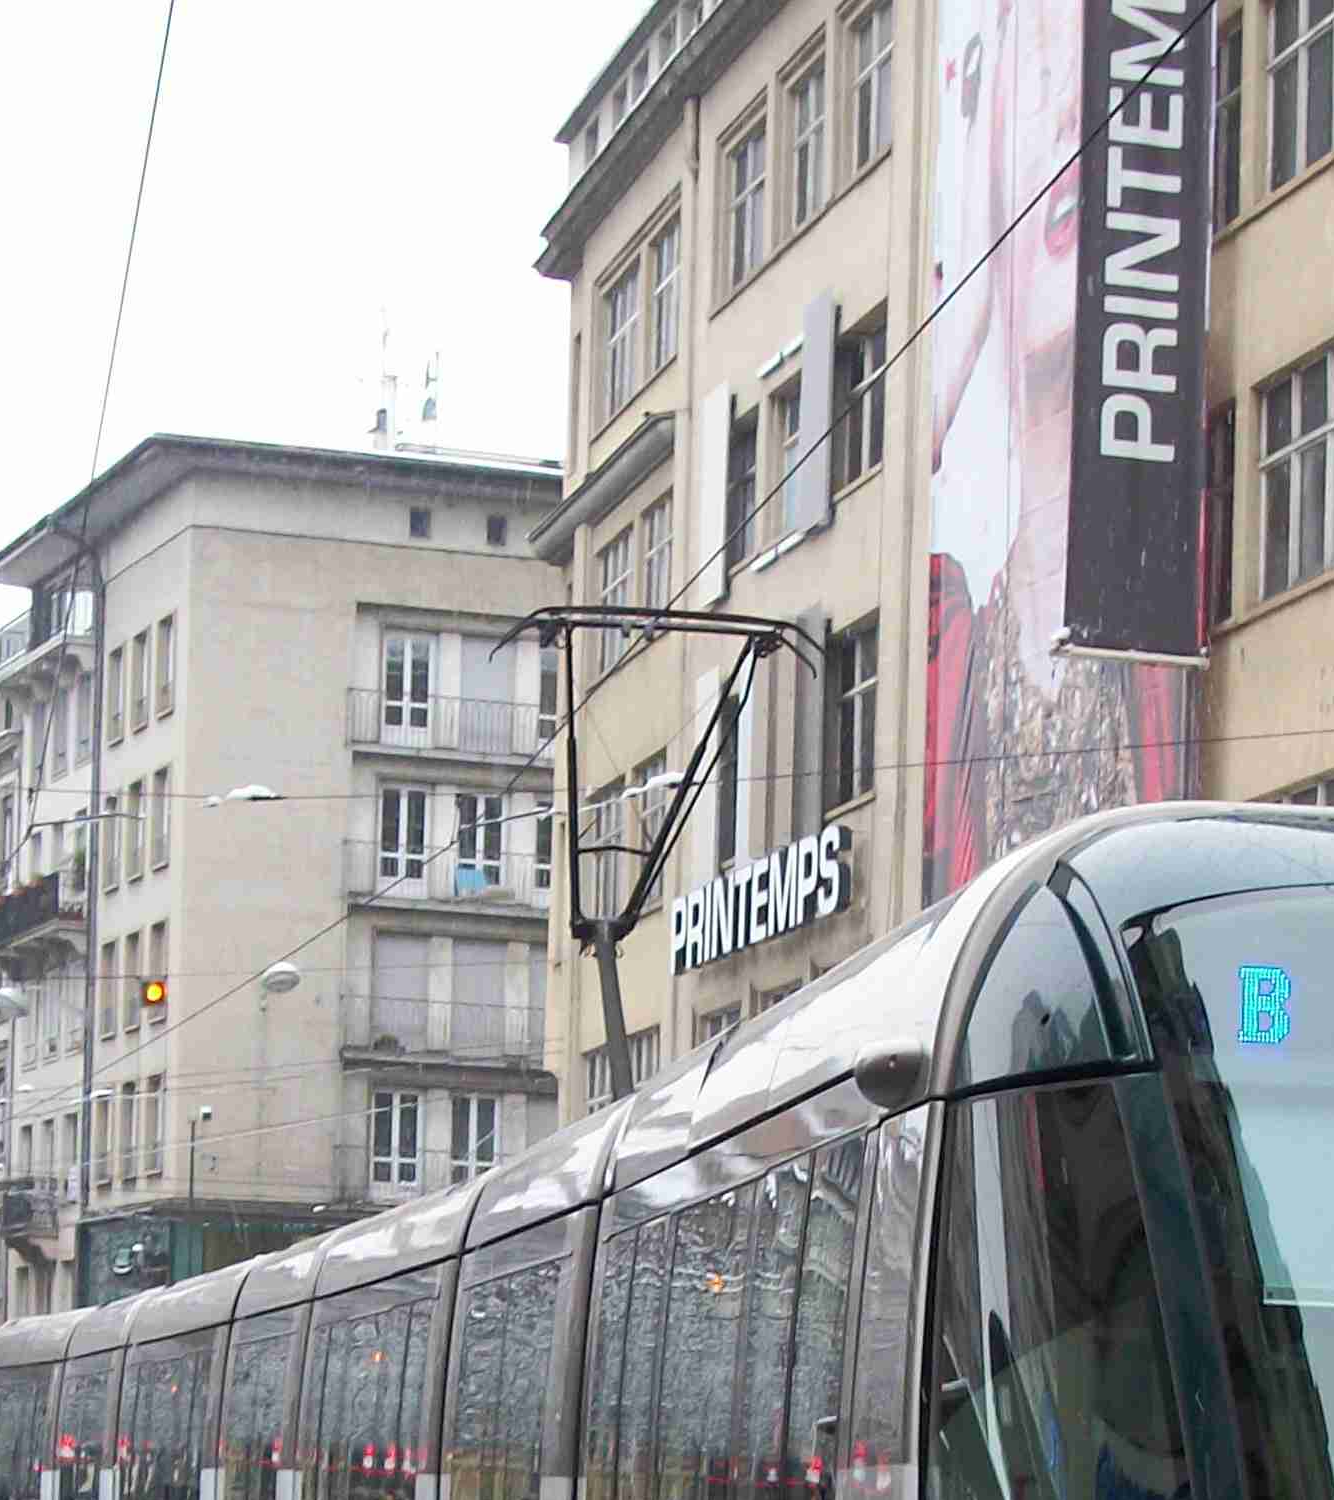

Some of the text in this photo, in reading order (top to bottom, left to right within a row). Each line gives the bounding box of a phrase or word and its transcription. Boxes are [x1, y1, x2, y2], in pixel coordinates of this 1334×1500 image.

[1099, 0, 1186, 464] PRINTEM
[670, 823, 845, 977] PRINTEMPS
[1237, 966, 1291, 1045] B
